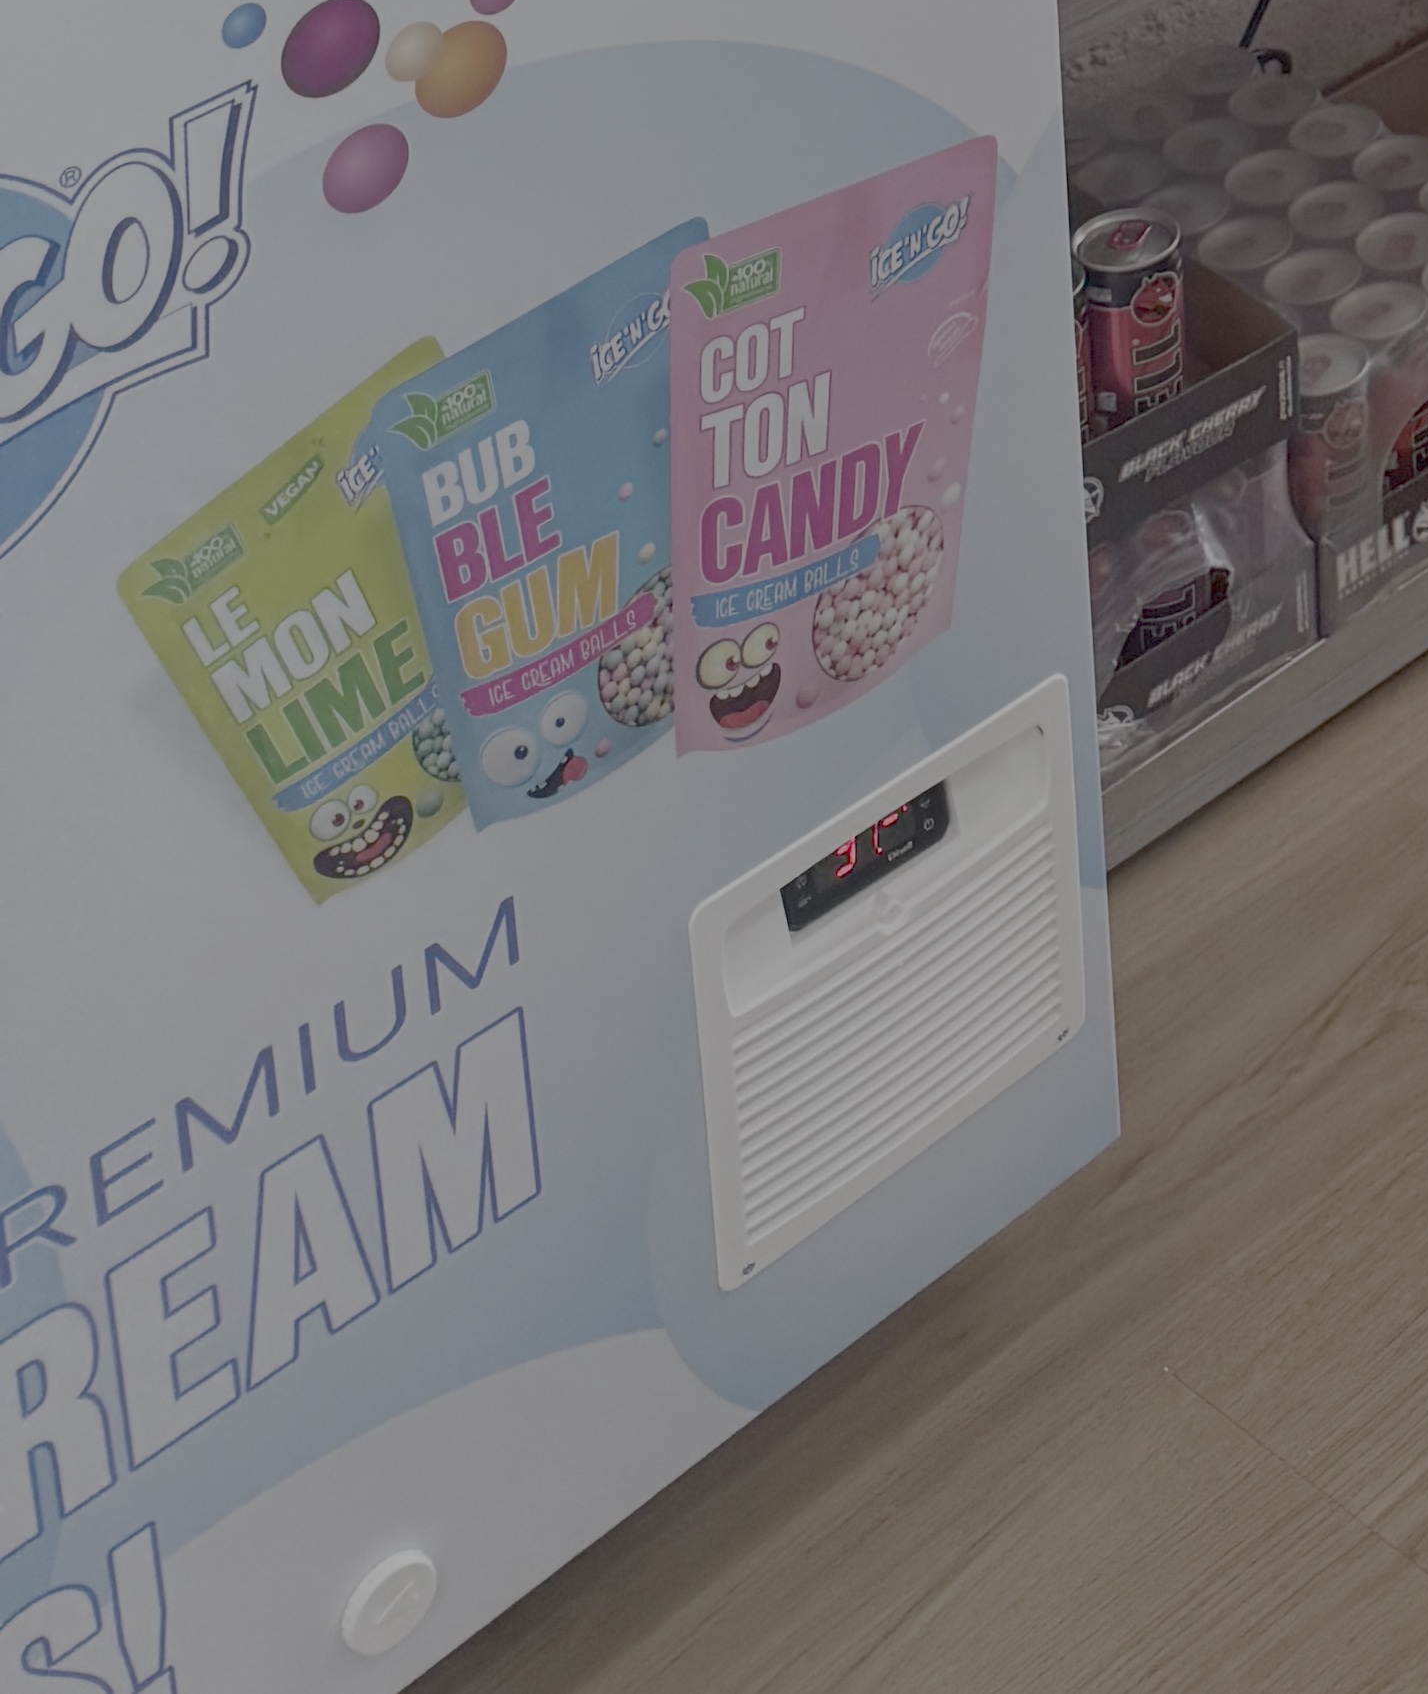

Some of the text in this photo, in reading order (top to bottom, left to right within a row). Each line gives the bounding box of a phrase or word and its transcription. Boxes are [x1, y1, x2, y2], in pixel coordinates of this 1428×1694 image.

[730, 269, 775, 301] natural
[700, 308, 806, 403] COT
[440, 392, 489, 427] natural
[700, 371, 832, 490] TON
[1118, 385, 1267, 483] BLACK CHERRY
[264, 460, 322, 522] VEGAN
[421, 419, 538, 526] BUB
[700, 419, 926, 586] CANDY
[432, 476, 564, 603] BLE
[714, 548, 860, 620] ICE CREAM BALLS
[1336, 510, 1412, 591] HELL
[181, 584, 260, 666] LE
[208, 568, 377, 723] MON
[454, 530, 623, 681] GUM
[243, 618, 427, 787] LIME
[488, 612, 638, 708] ICE CREAM BALLS
[300, 732, 386, 802] ICE CREAM
[0, 895, 520, 1288] REMIUM
[0, 1005, 543, 1563] REAM
